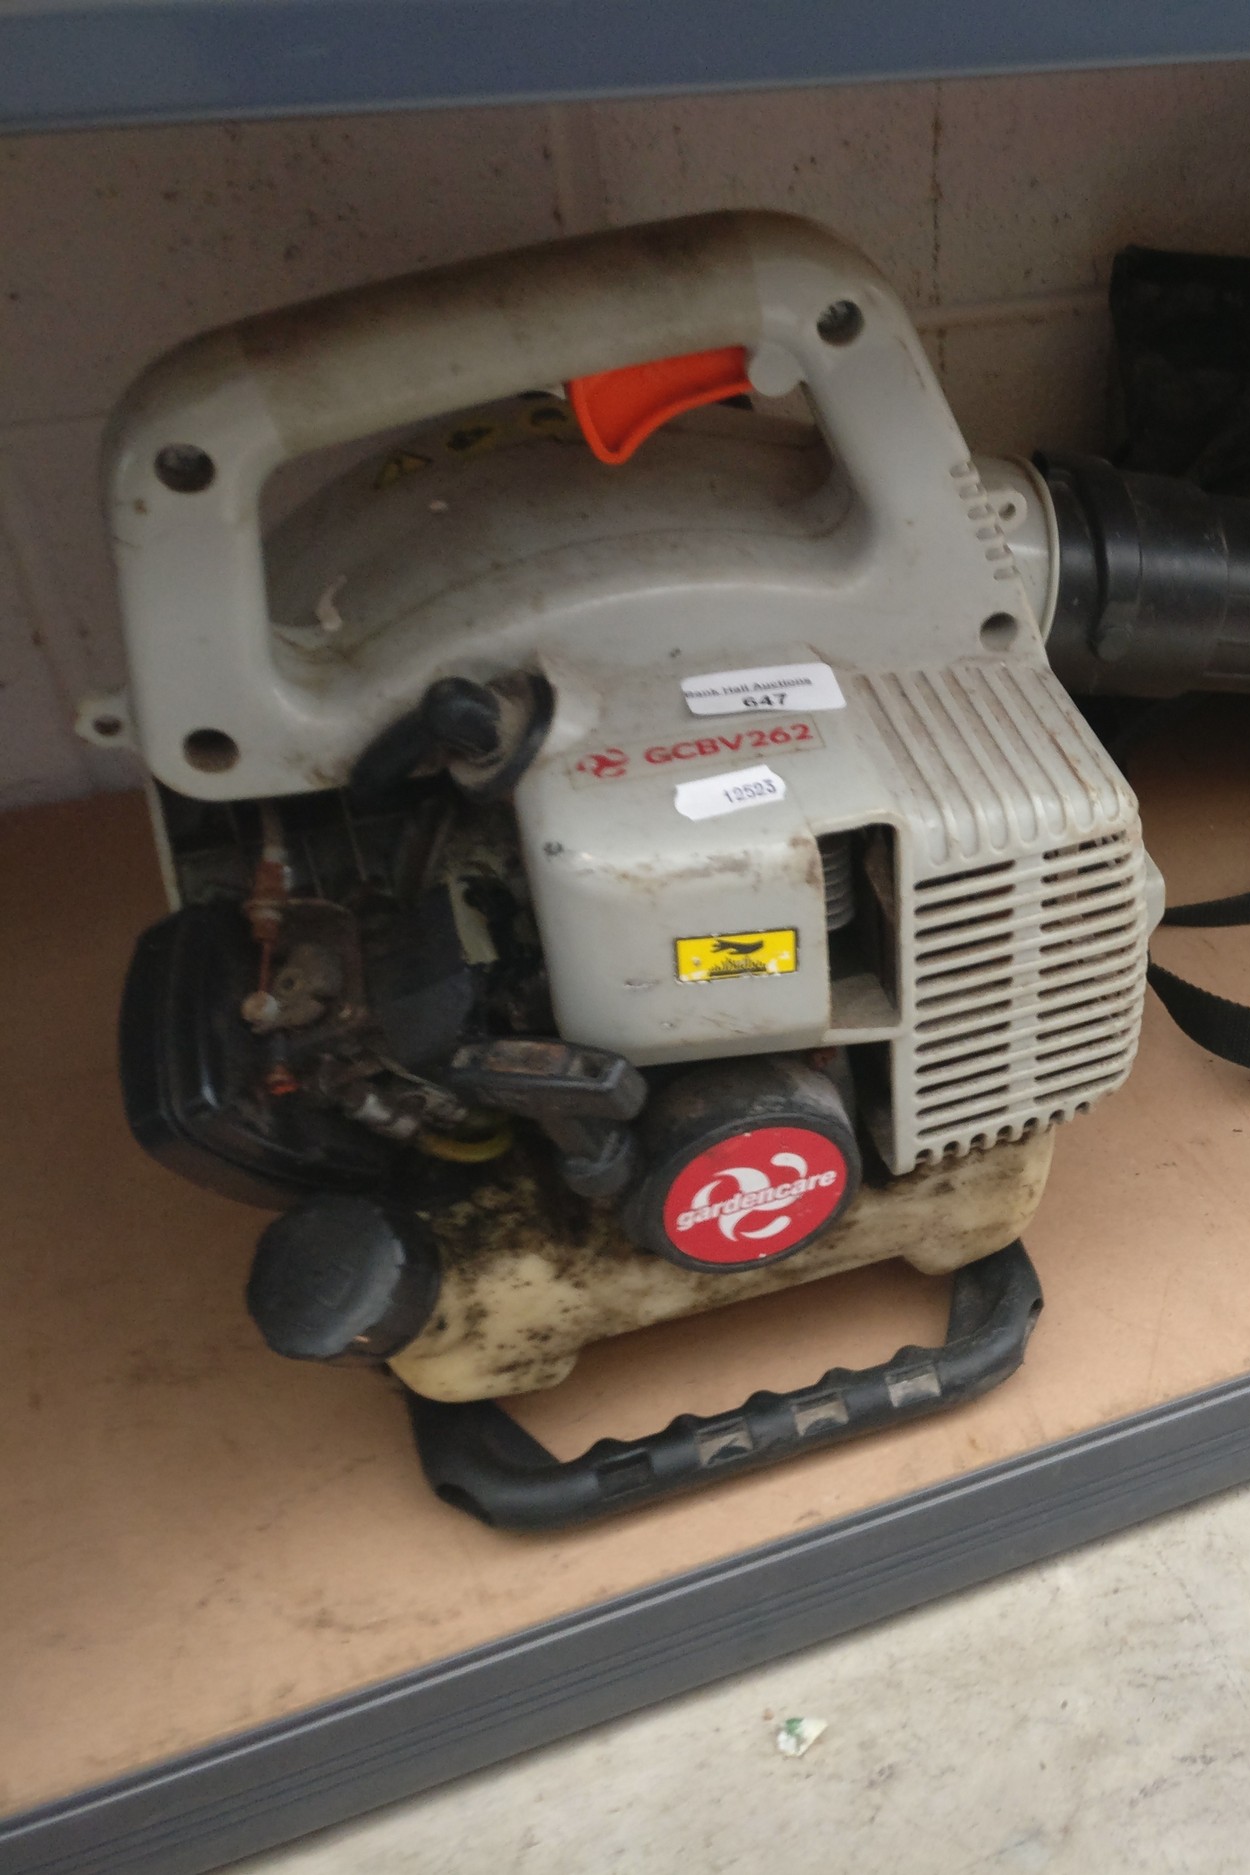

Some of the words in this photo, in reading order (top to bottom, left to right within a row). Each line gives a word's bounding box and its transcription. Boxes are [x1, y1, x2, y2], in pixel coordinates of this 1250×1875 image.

[722, 683, 750, 695] Hall
[753, 677, 812, 691] Auctions
[742, 693, 787, 707] 647
[644, 723, 813, 764] GCBV262
[723, 778, 777, 803] 12523
[676, 1170, 837, 1232] gardencare
